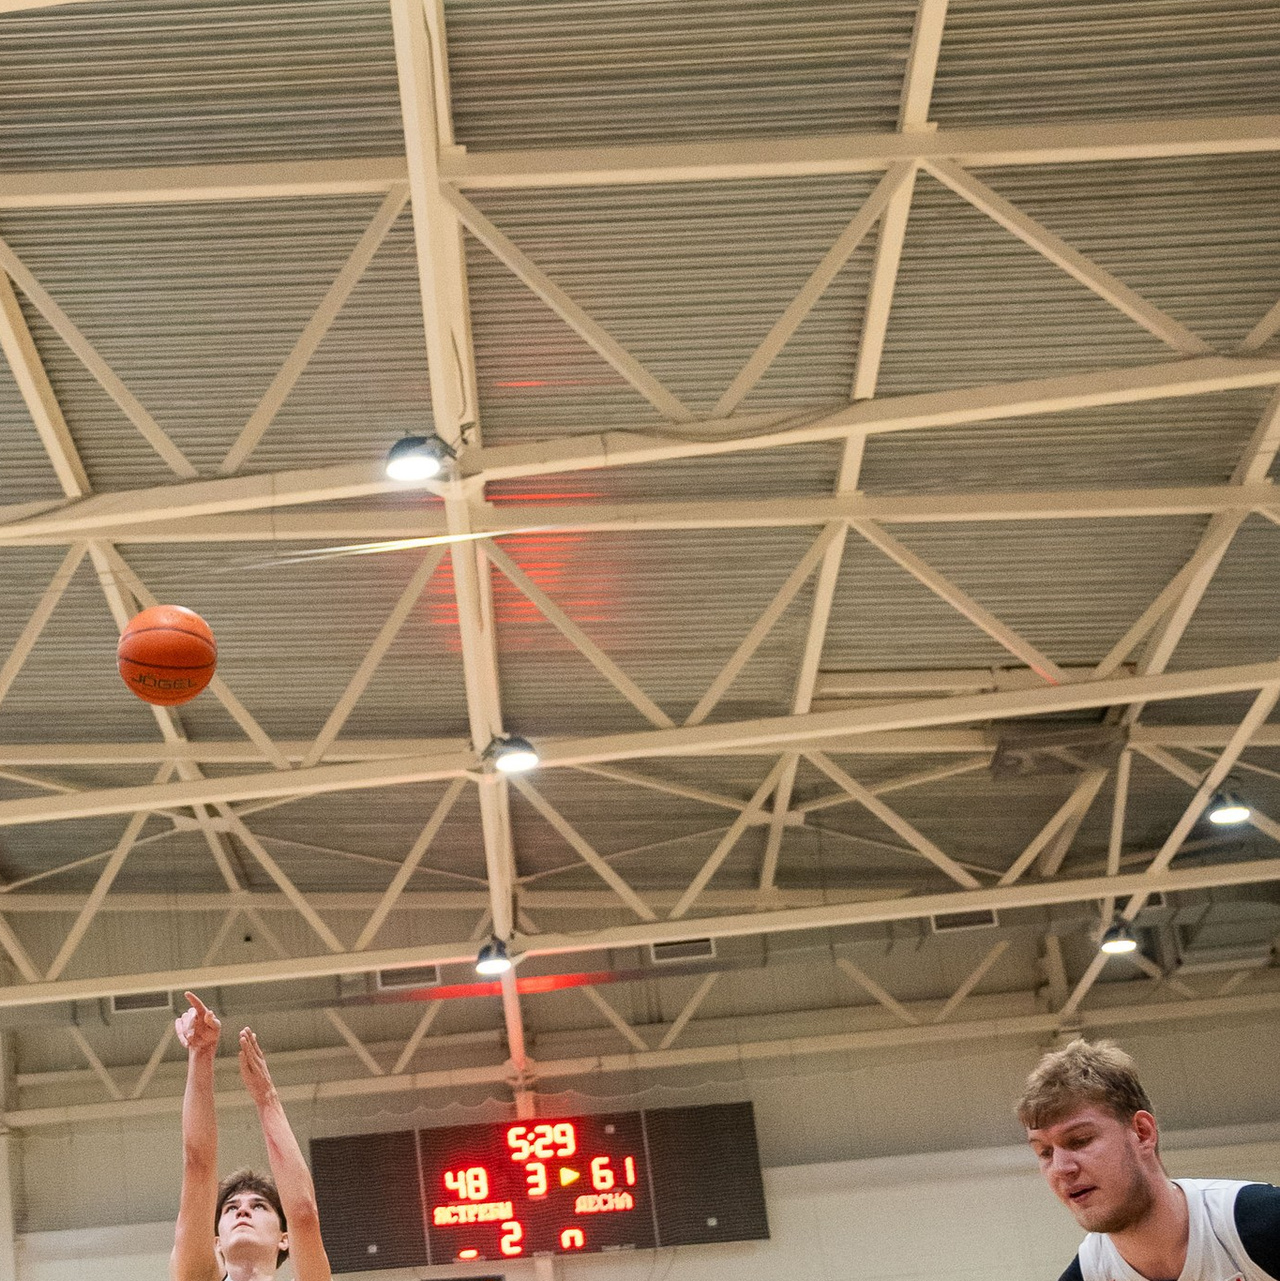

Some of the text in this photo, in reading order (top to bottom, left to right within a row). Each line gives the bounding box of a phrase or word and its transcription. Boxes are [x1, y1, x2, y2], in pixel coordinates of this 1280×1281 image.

[507, 1123, 576, 1160] 5:29
[444, 1156, 636, 1200] 48 3 61
[433, 1201, 514, 1226] ЯСТРЕБЫ
